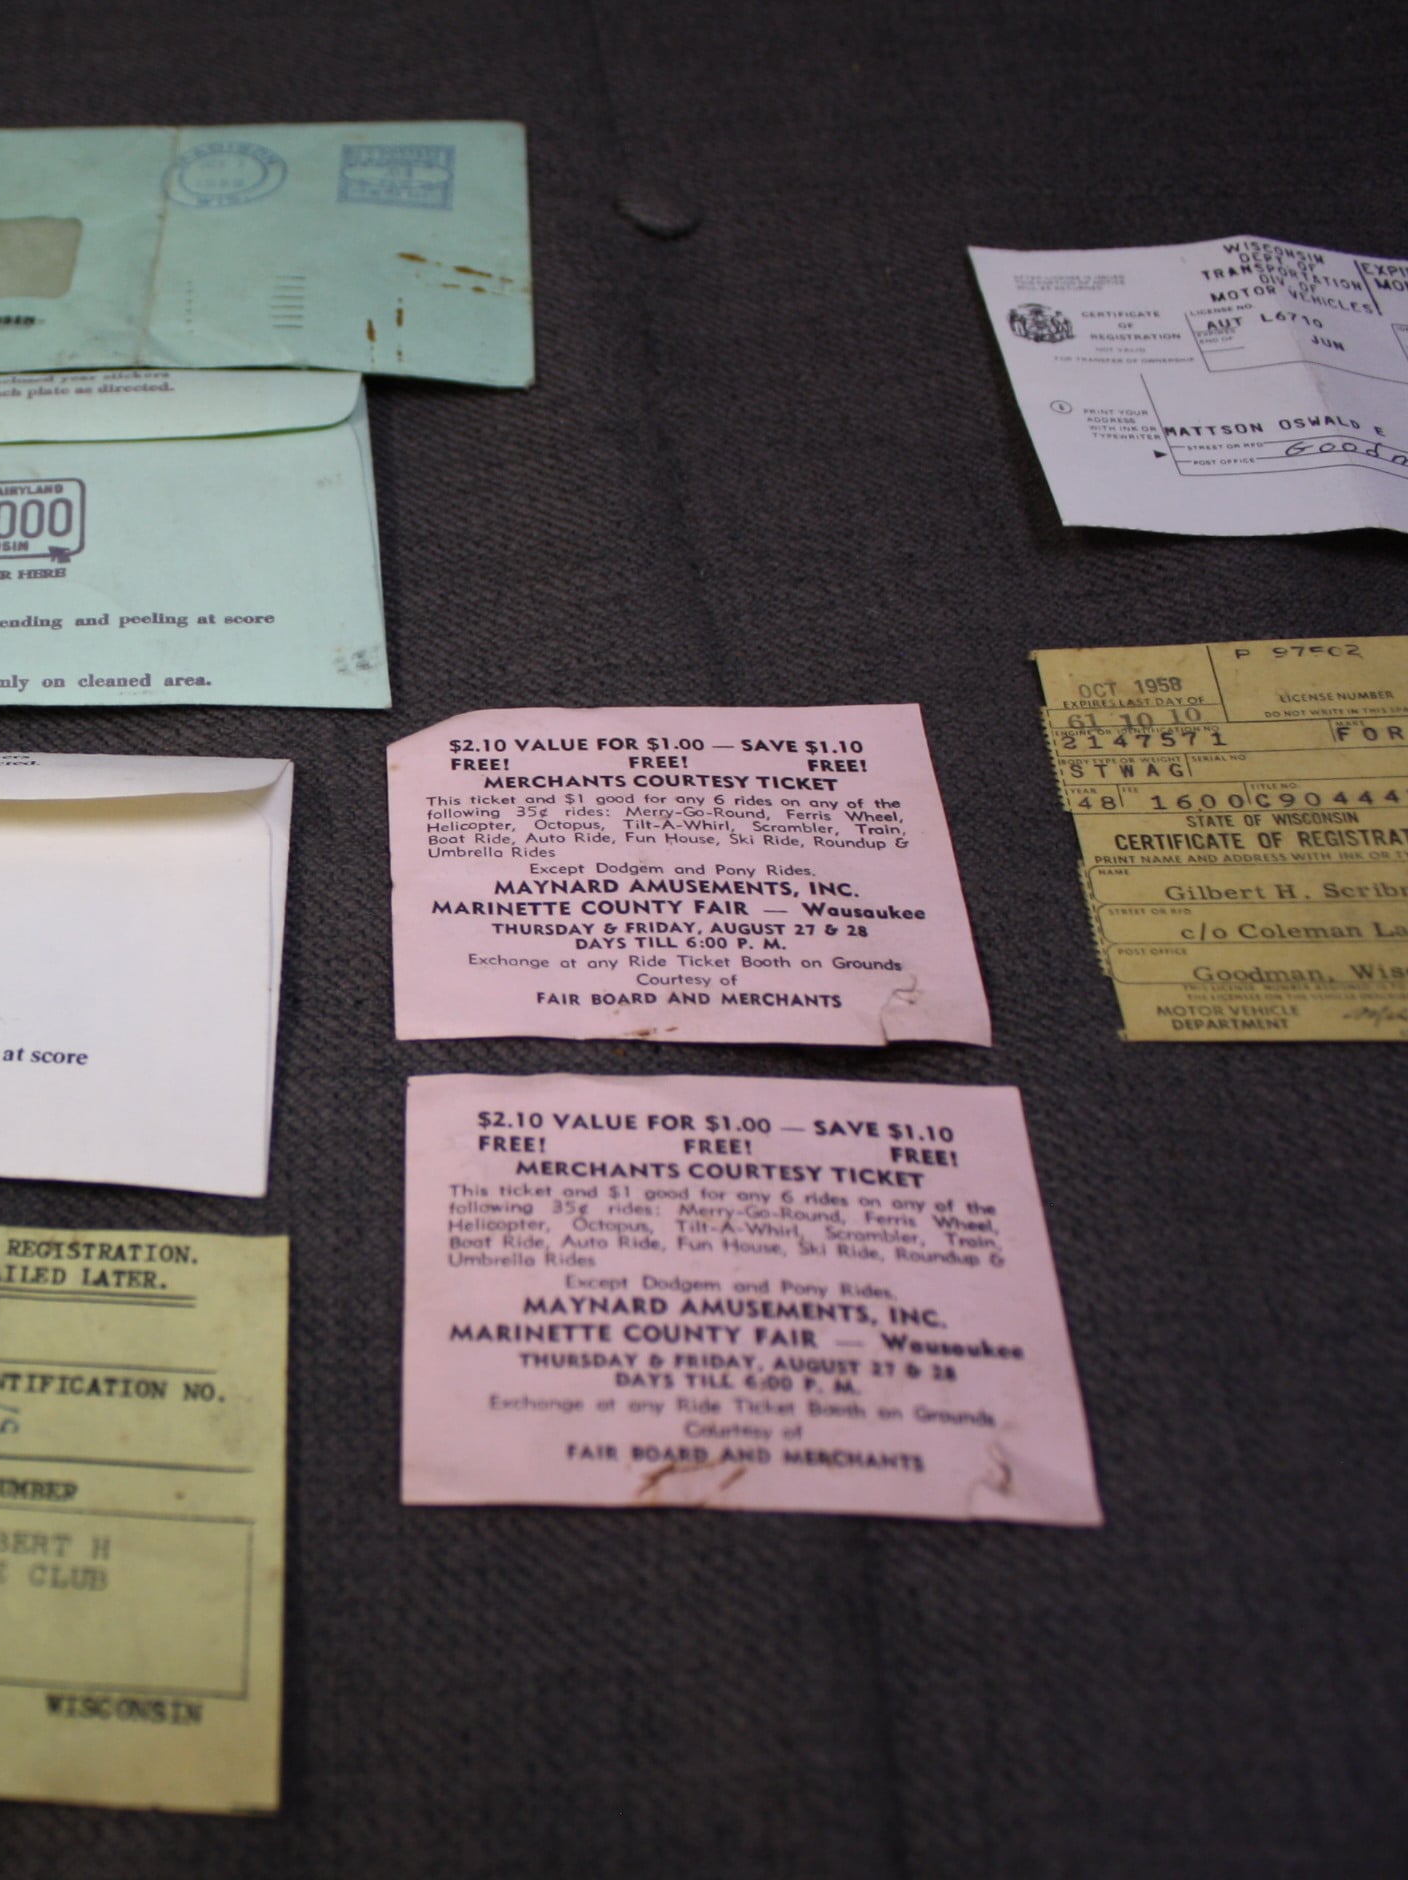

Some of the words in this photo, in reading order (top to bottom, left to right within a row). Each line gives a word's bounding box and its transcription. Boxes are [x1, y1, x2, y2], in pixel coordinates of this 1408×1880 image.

[1223, 242, 1324, 266] WISCONSIN
[1201, 264, 1362, 292] TRANSPORTATION
[1210, 286, 1276, 303] MOTOR
[1289, 290, 1374, 314] VEHICLES
[1207, 316, 1243, 330] AUT
[1311, 335, 1345, 352] JUN
[1165, 422, 1263, 437] MATTSON
[1279, 416, 1360, 430] OSWALD
[1374, 426, 1386, 437] E
[17, 568, 66, 579] HERE
[42, 676, 65, 688] on
[78, 673, 151, 688] cleaned
[164, 675, 211, 687] area.
[1078, 682, 1117, 698] OCT
[1134, 678, 1182, 694] 1958
[1279, 692, 1333, 703] LICENSE
[1336, 691, 1392, 701] NUMBER
[449, 739, 506, 754] $2.10
[515, 739, 588, 751] VALUE
[597, 738, 639, 750] FOR
[647, 738, 704, 752] $1.00
[741, 739, 797, 752] SAVE
[806, 740, 863, 754] $1.10
[451, 758, 509, 771] FREE!
[629, 757, 687, 768] FREE!
[808, 760, 867, 772] FREE!
[484, 776, 626, 788] MERCHANTS
[630, 775, 750, 788] COURTESY
[756, 776, 837, 791] TICKET
[427, 821, 515, 834] Helicopter,
[534, 819, 605, 832] Octopus,
[623, 819, 735, 832] Tilt-A-Whirl,
[753, 821, 839, 836] Scrambler,
[855, 824, 906, 836] Train,
[1186, 814, 1235, 828] STATE
[1244, 814, 1262, 826] OF
[1273, 811, 1359, 826] WISCONSIN
[1114, 832, 1243, 852] CERTIFICATE
[1258, 832, 1283, 848] OF
[530, 864, 584, 876] Except
[596, 863, 664, 875] Dodgem
[675, 864, 705, 875] and
[716, 865, 755, 878] Pony
[767, 865, 816, 877] Rides.
[494, 880, 619, 895] MAYNARD
[629, 880, 799, 898] AMUSEMENTS,
[809, 882, 859, 898] INC.
[1165, 884, 1265, 902] Gilbert
[432, 901, 571, 916] MARINETTE
[582, 900, 683, 915] COUNTY
[695, 902, 749, 915] FAIR
[802, 902, 926, 920] Wausaukee
[1181, 922, 1227, 942] c/o
[1238, 923, 1363, 940] Coleman
[1193, 965, 1335, 985] Goodman,
[537, 992, 580, 1005] FAIR
[592, 993, 657, 1005] BOARD
[667, 993, 710, 1005] AND
[721, 993, 842, 1008] MERCHANTS
[1156, 1005, 1224, 1019] MOTOR
[1228, 1005, 1299, 1017] VEHICLE
[1172, 1018, 1289, 1031] DEPARTMENT
[3, 1047, 24, 1061] at
[30, 1050, 88, 1065] score
[478, 1111, 543, 1129] $2.10
[553, 1114, 637, 1131] VALUE
[647, 1115, 695, 1131] FOR
[706, 1115, 770, 1133] $1.00
[814, 1119, 880, 1138] SAVE
[888, 1123, 954, 1143] $1.10
[516, 1161, 680, 1179] MERCHANTS
[688, 1163, 822, 1182] COURTESY
[831, 1167, 924, 1189] TICKET
[7, 1238, 198, 1265] REGISTRATION.
[523, 1298, 668, 1315] MAYNARD
[680, 1299, 878, 1326] AMUSEMENTS,
[890, 1308, 946, 1329] INC.
[92, 1537, 111, 1560] H
[29, 1565, 109, 1592] CLUB
